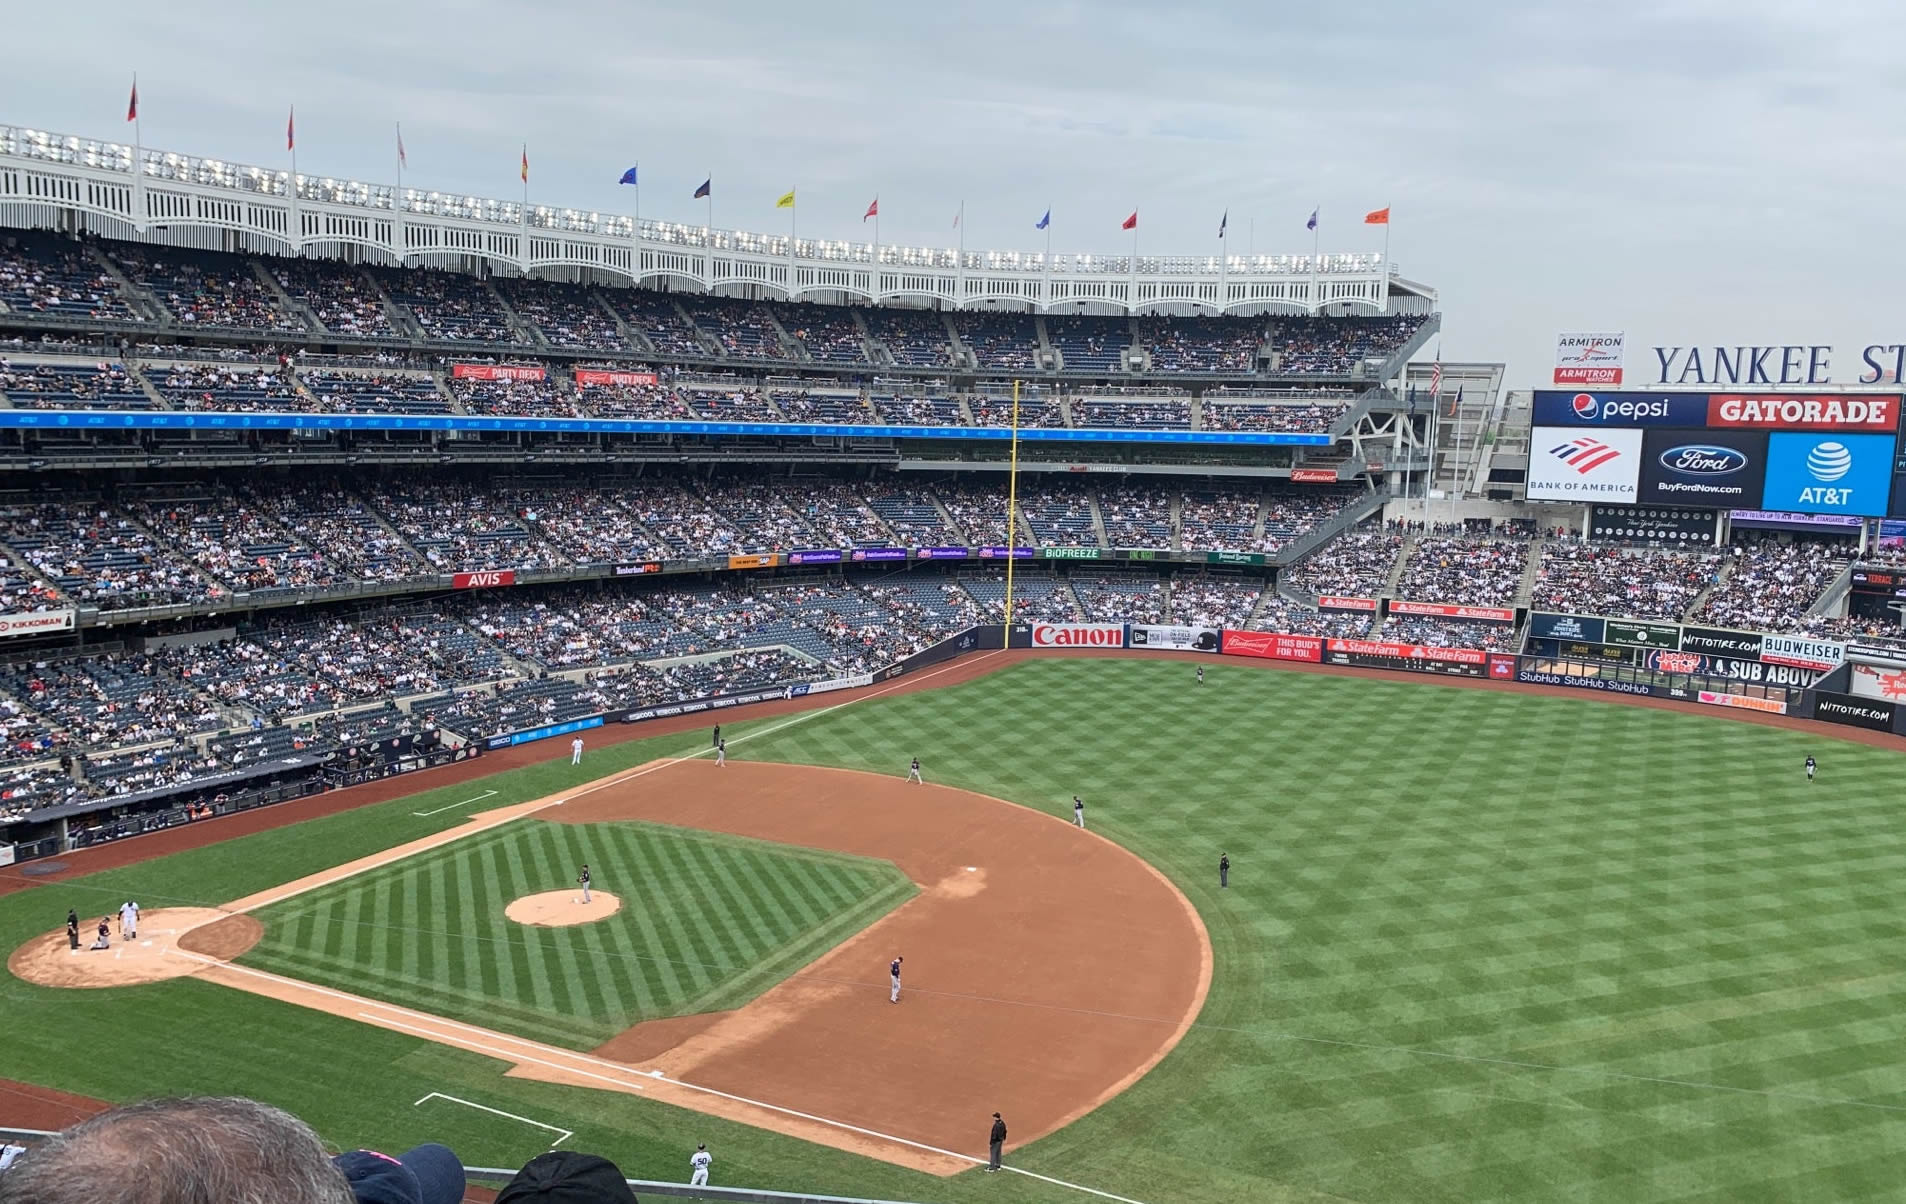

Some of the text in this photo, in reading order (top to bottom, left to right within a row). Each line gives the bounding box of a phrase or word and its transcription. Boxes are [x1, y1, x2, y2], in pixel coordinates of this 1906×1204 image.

[1560, 338, 1621, 346] ARMITRON
[1652, 346, 1832, 384] YANKEE
[492, 368, 518, 378] PARTY
[518, 369, 540, 380] DECK
[610, 374, 632, 384] PARTY
[1560, 370, 1616, 378] ARMITRON
[1603, 399, 1668, 420] pepsi
[1720, 400, 1887, 423] GATORADE
[1676, 449, 1730, 470] Ford
[1292, 470, 1336, 480] Budweiser
[1530, 481, 1634, 493] BANK OF AMERICA
[1658, 482, 1742, 494] BuyFordNow.com
[1798, 488, 1852, 505] AT&T
[1640, 520, 1654, 528] York
[1655, 520, 1678, 529] Yankees
[468, 572, 500, 586] AVIS
[12, 618, 62, 628] KIKKOMAN
[1034, 626, 1122, 645] Canon
[1277, 638, 1320, 649] THIS BUD'S
[1682, 634, 1762, 654] NITTOTIRE.COM
[1766, 638, 1840, 659] BUDWEISER
[1277, 648, 1312, 658] FOR YOU.
[1656, 650, 1700, 667] Jersey
[1730, 661, 1762, 680] SUB
[1520, 672, 1648, 694] StubHub StubHub StubHub
[1820, 701, 1890, 722] NITTOTIRE.COM
[490, 737, 510, 746] GEICO
